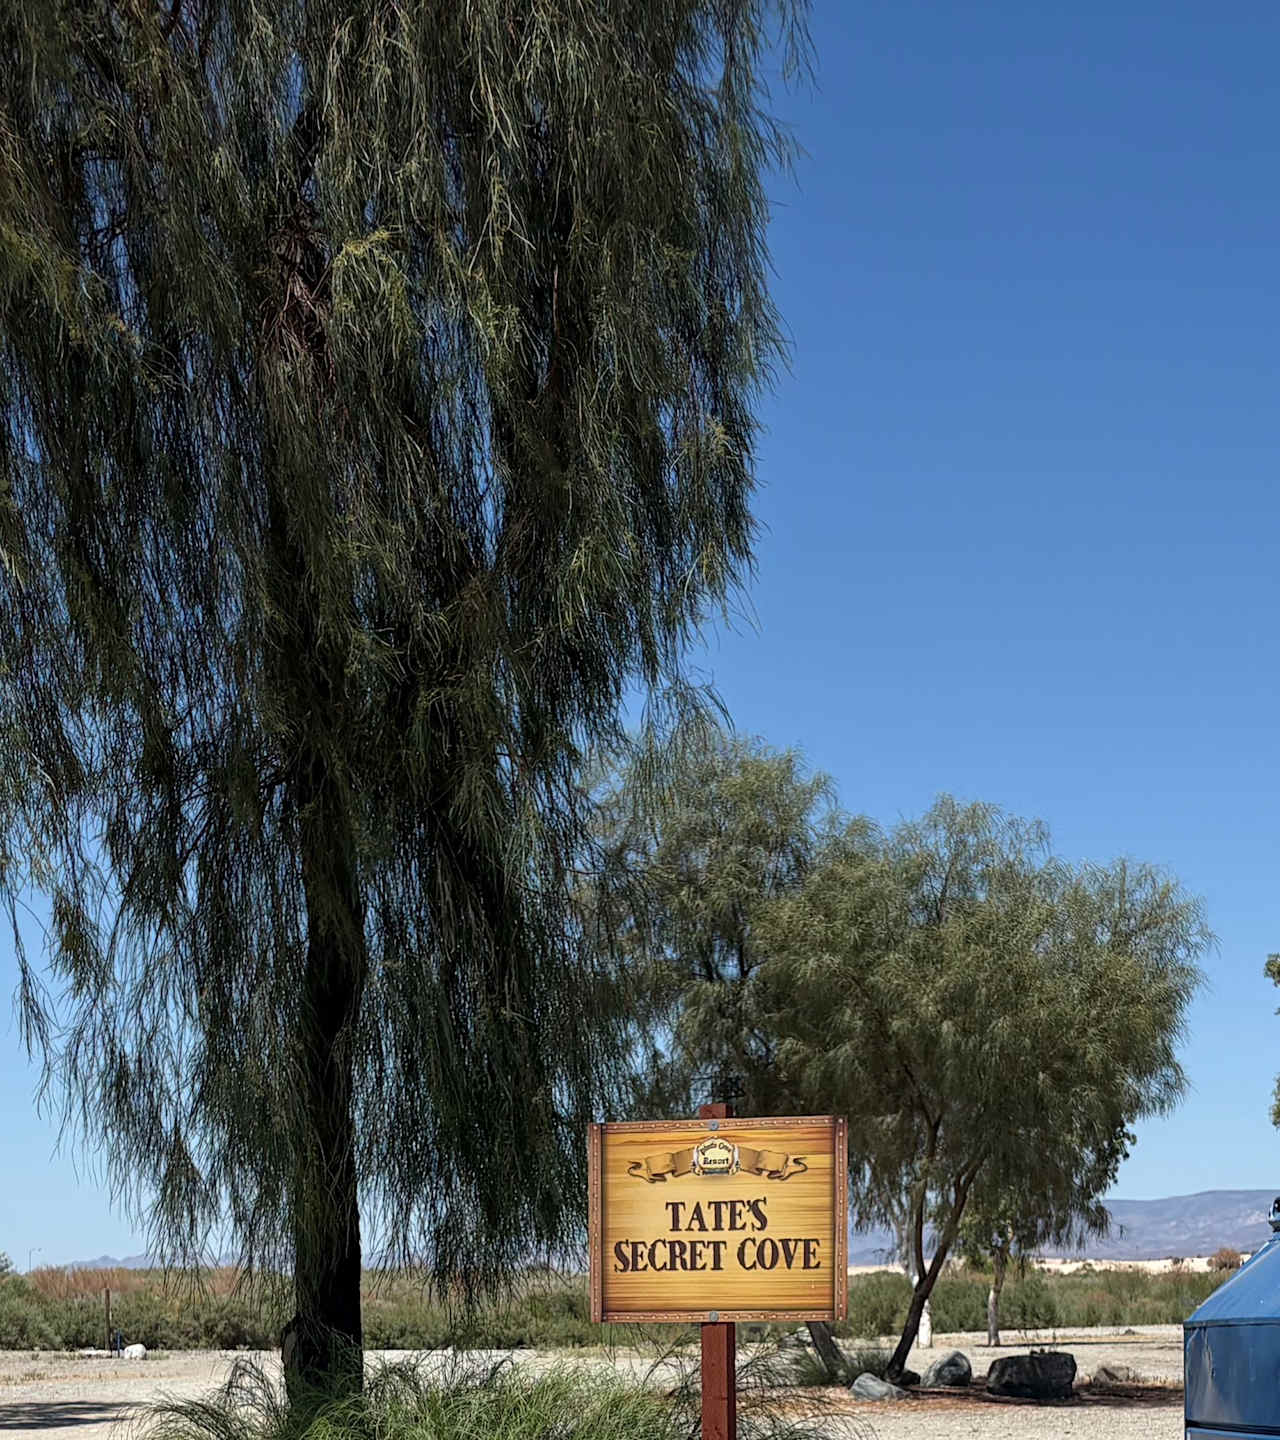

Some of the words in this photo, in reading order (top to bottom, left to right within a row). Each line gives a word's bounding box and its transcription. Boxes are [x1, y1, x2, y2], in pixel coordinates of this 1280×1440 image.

[665, 1197, 768, 1232] TATE'S
[614, 1239, 727, 1273] SECRET
[737, 1238, 821, 1271] COVE
